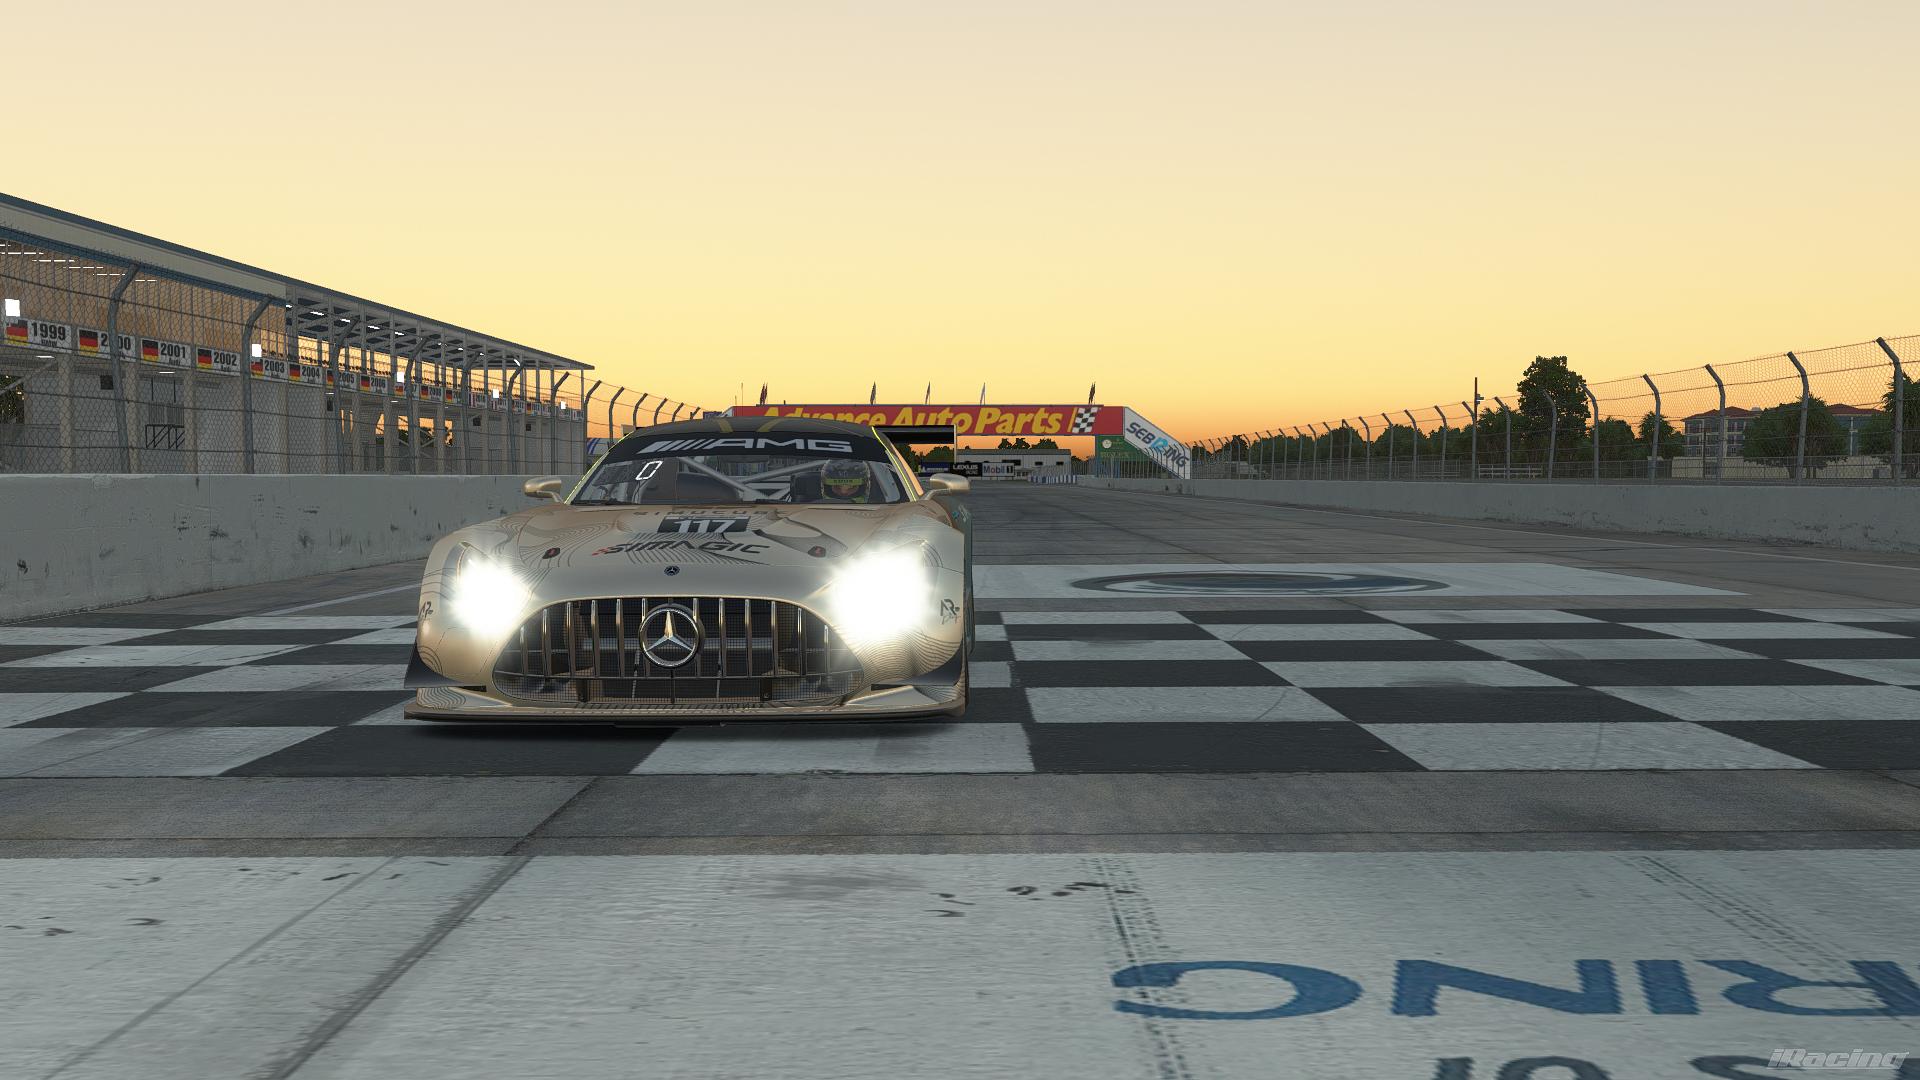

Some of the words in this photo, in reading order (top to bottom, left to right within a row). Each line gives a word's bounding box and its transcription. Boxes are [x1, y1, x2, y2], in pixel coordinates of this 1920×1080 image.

[31, 322, 66, 341] 1999
[160, 342, 186, 359] 2001
[213, 351, 238, 367] 2002
[264, 360, 285, 374] 2003
[301, 366, 321, 379] 2004
[974, 407, 1063, 434] Parts
[702, 438, 853, 453] AMG
[983, 465, 1005, 474] Mobil
[673, 519, 736, 533] 117
[603, 540, 770, 555] SIMAGIC
